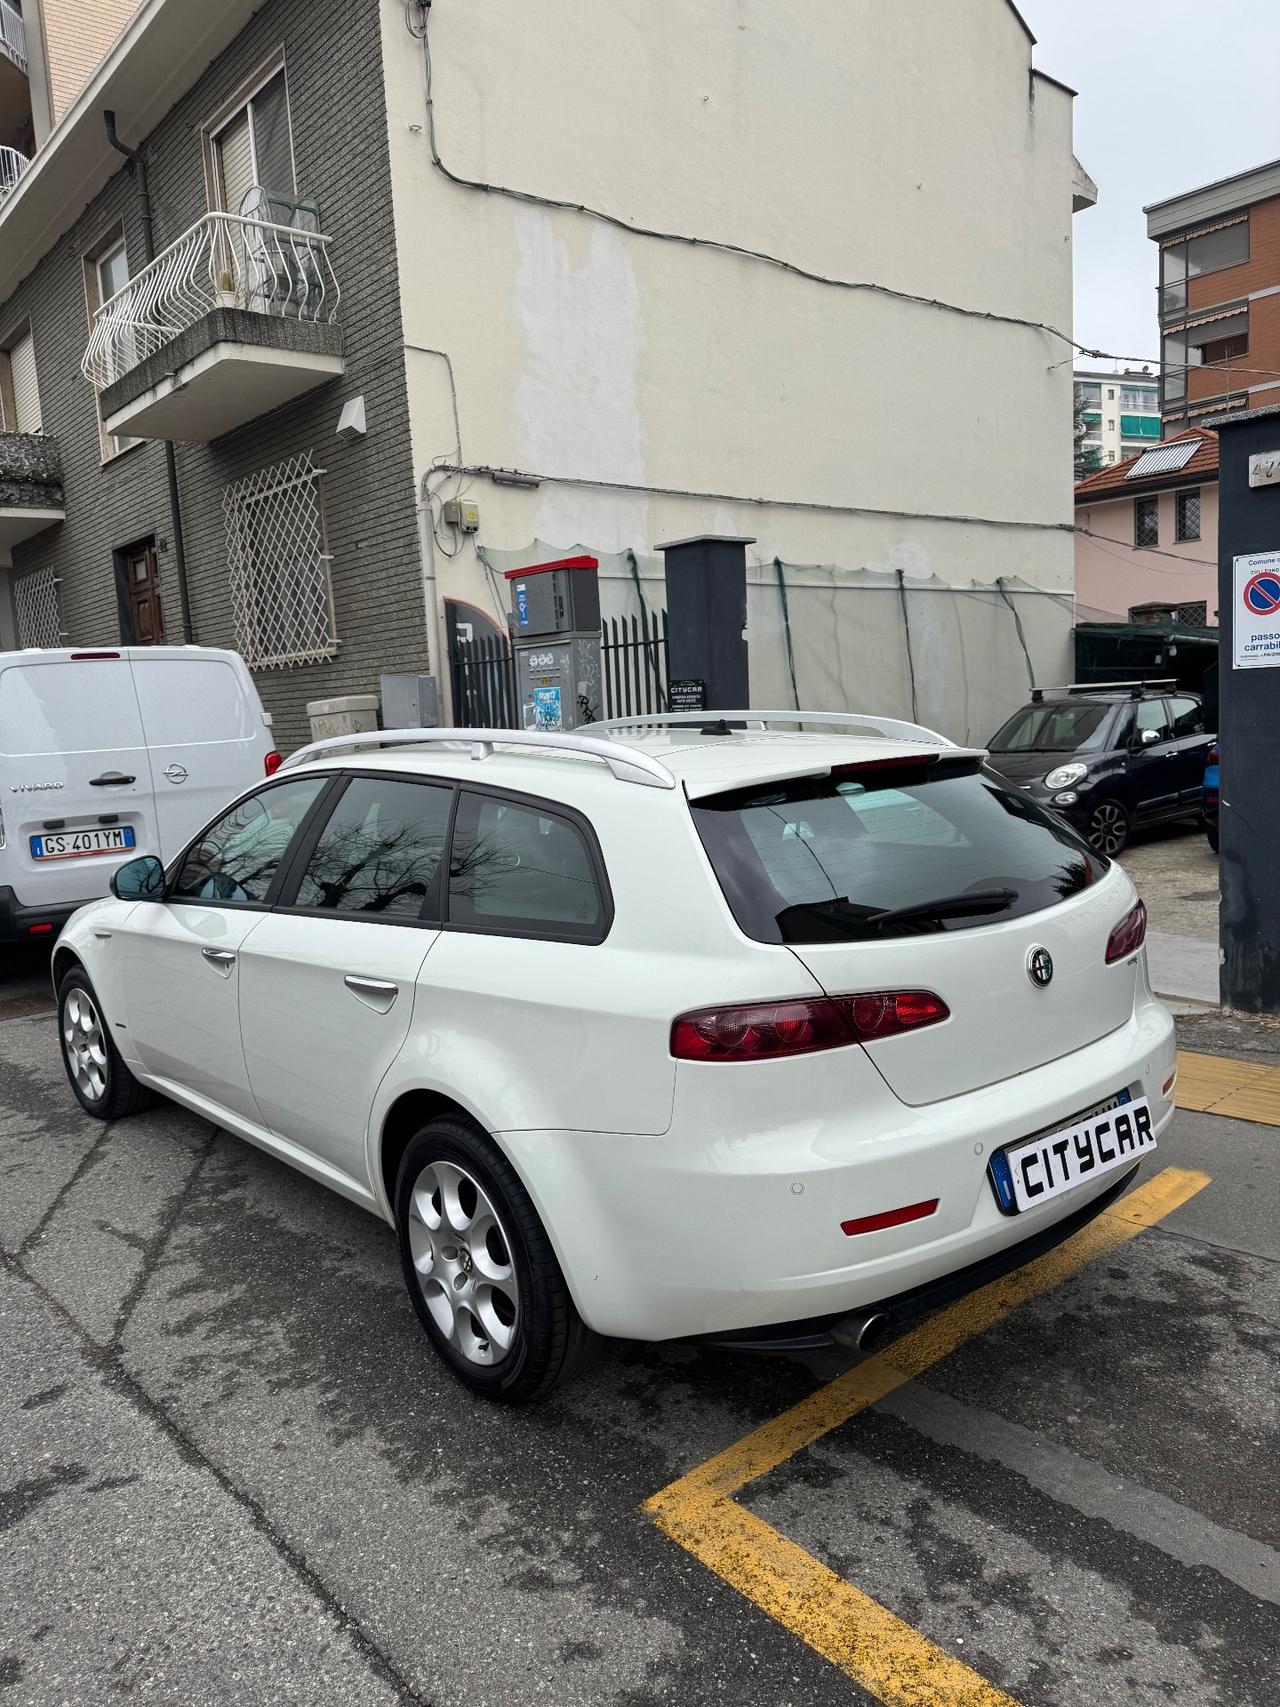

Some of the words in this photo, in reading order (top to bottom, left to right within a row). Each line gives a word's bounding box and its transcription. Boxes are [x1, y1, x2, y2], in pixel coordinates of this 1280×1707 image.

[1248, 558, 1276, 566] Comune
[1251, 632, 1280, 643] passo
[671, 686, 703, 694] CITYCAR
[9, 781, 64, 793] VIVARO
[1021, 1105, 1154, 1198] CITYCAR
